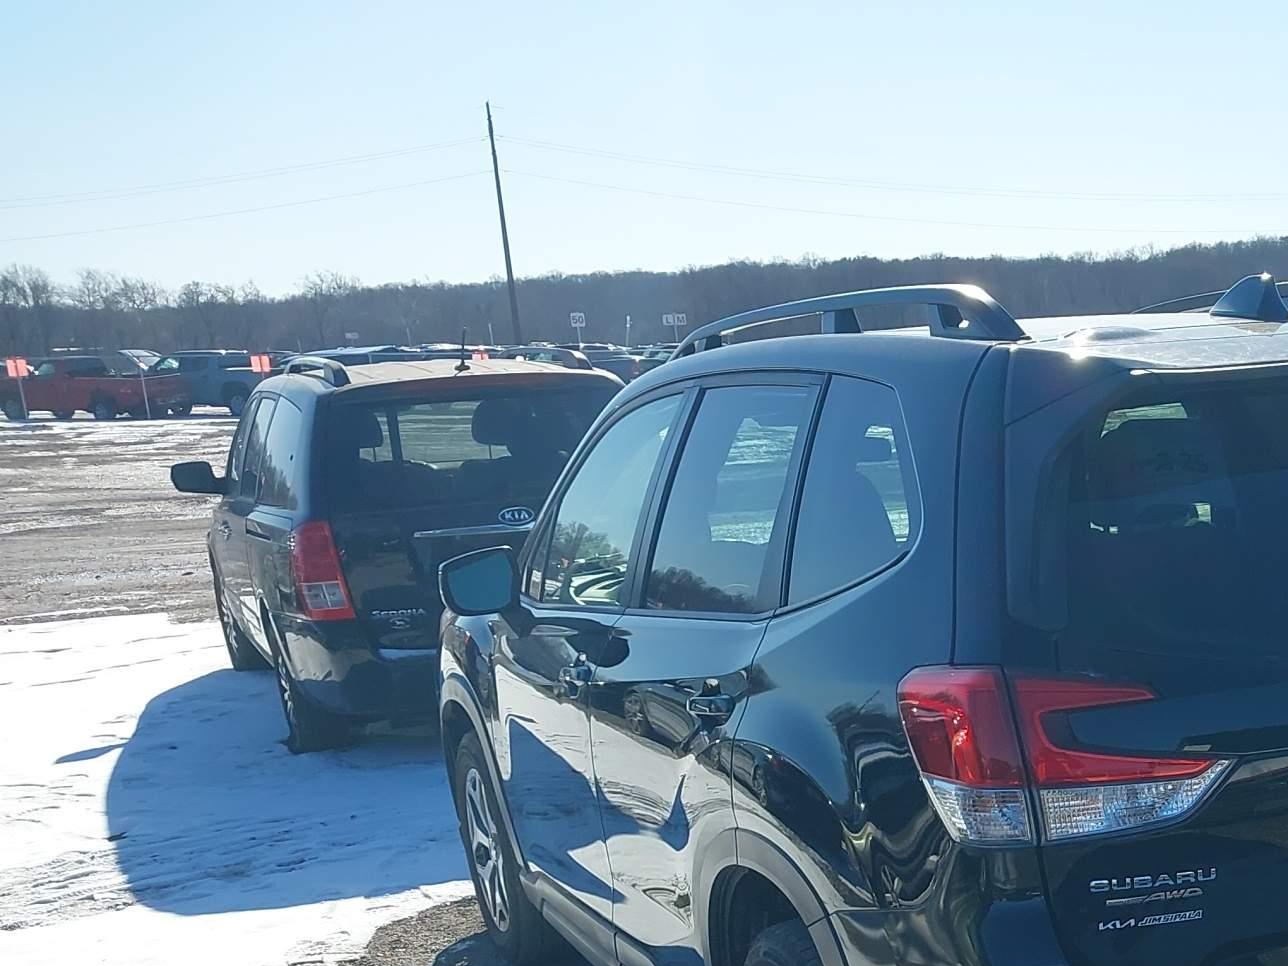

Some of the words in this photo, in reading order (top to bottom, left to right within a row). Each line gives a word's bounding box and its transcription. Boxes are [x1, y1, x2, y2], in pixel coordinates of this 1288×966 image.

[571, 315, 584, 324] 50
[503, 510, 530, 521] KIA
[1089, 867, 1217, 893] SUBARU
[1143, 887, 1203, 903] AWD
